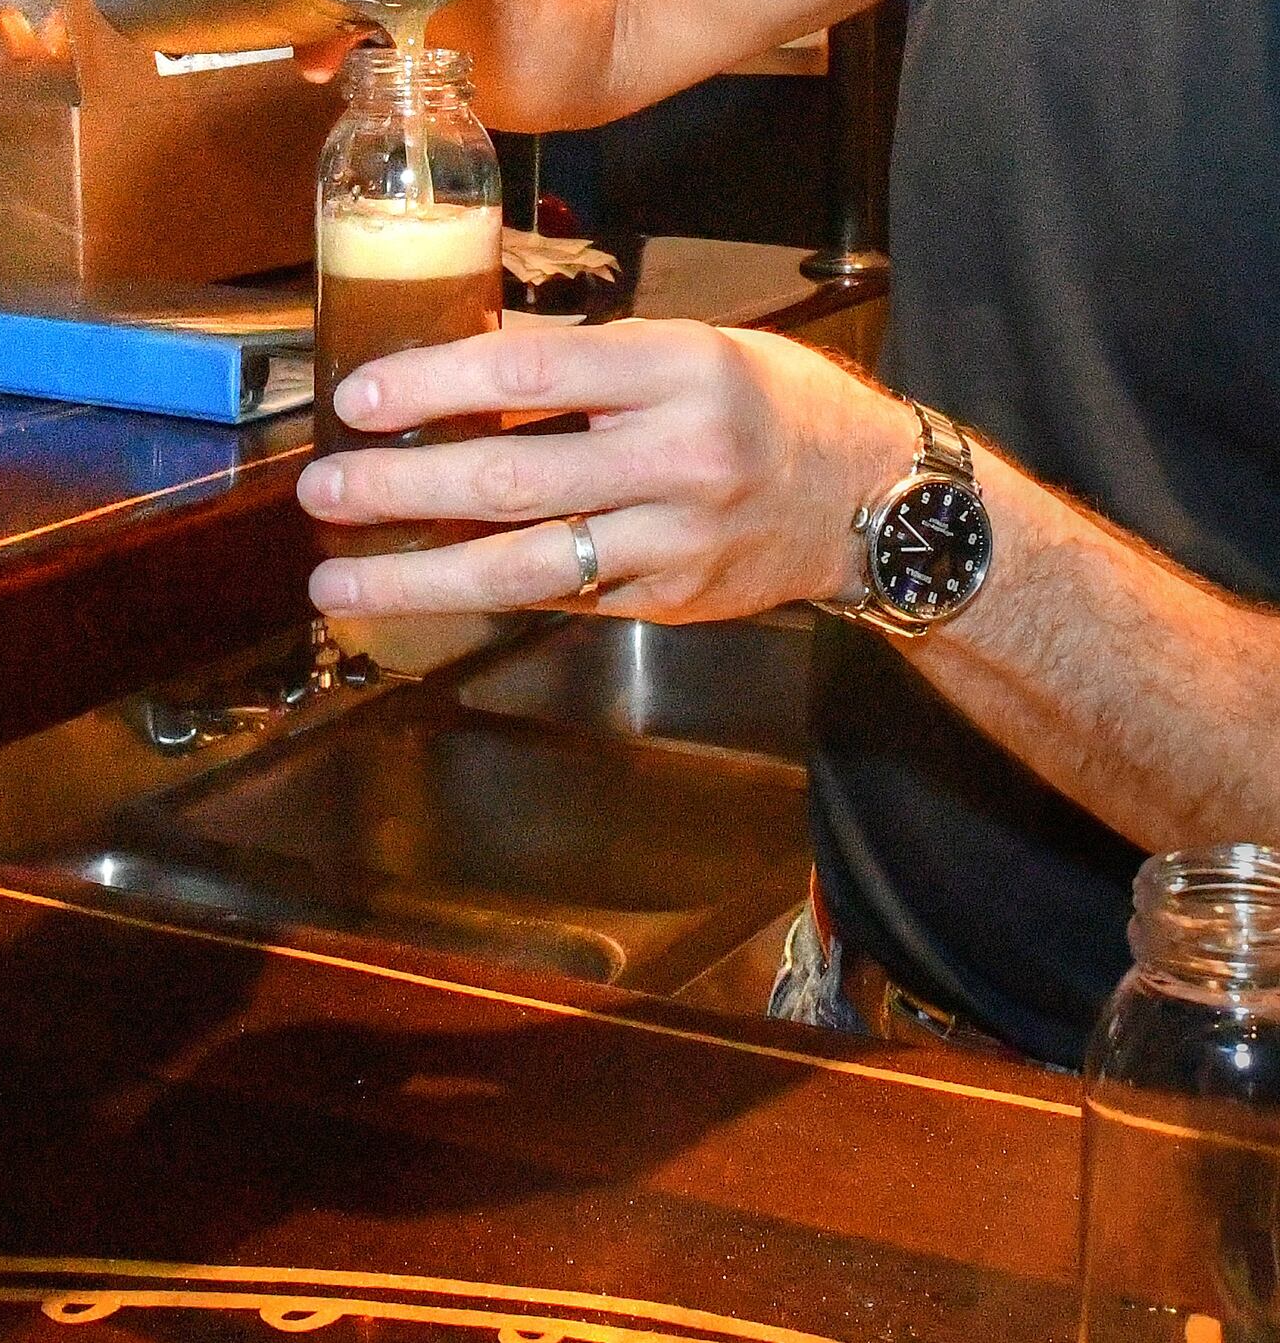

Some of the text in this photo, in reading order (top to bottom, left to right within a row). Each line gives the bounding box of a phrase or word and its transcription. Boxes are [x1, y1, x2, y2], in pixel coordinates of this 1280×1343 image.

[921, 492, 931, 505] 5
[943, 494, 953, 506] 6
[900, 503, 910, 515] 4
[960, 510, 969, 522] 7
[884, 525, 894, 537] 3
[968, 533, 978, 545] 8
[881, 551, 891, 564] 2
[965, 560, 974, 571] 9
[890, 576, 897, 587] 1
[947, 578, 959, 592] 10
[905, 589, 917, 603] 12
[928, 592, 938, 604] 11
